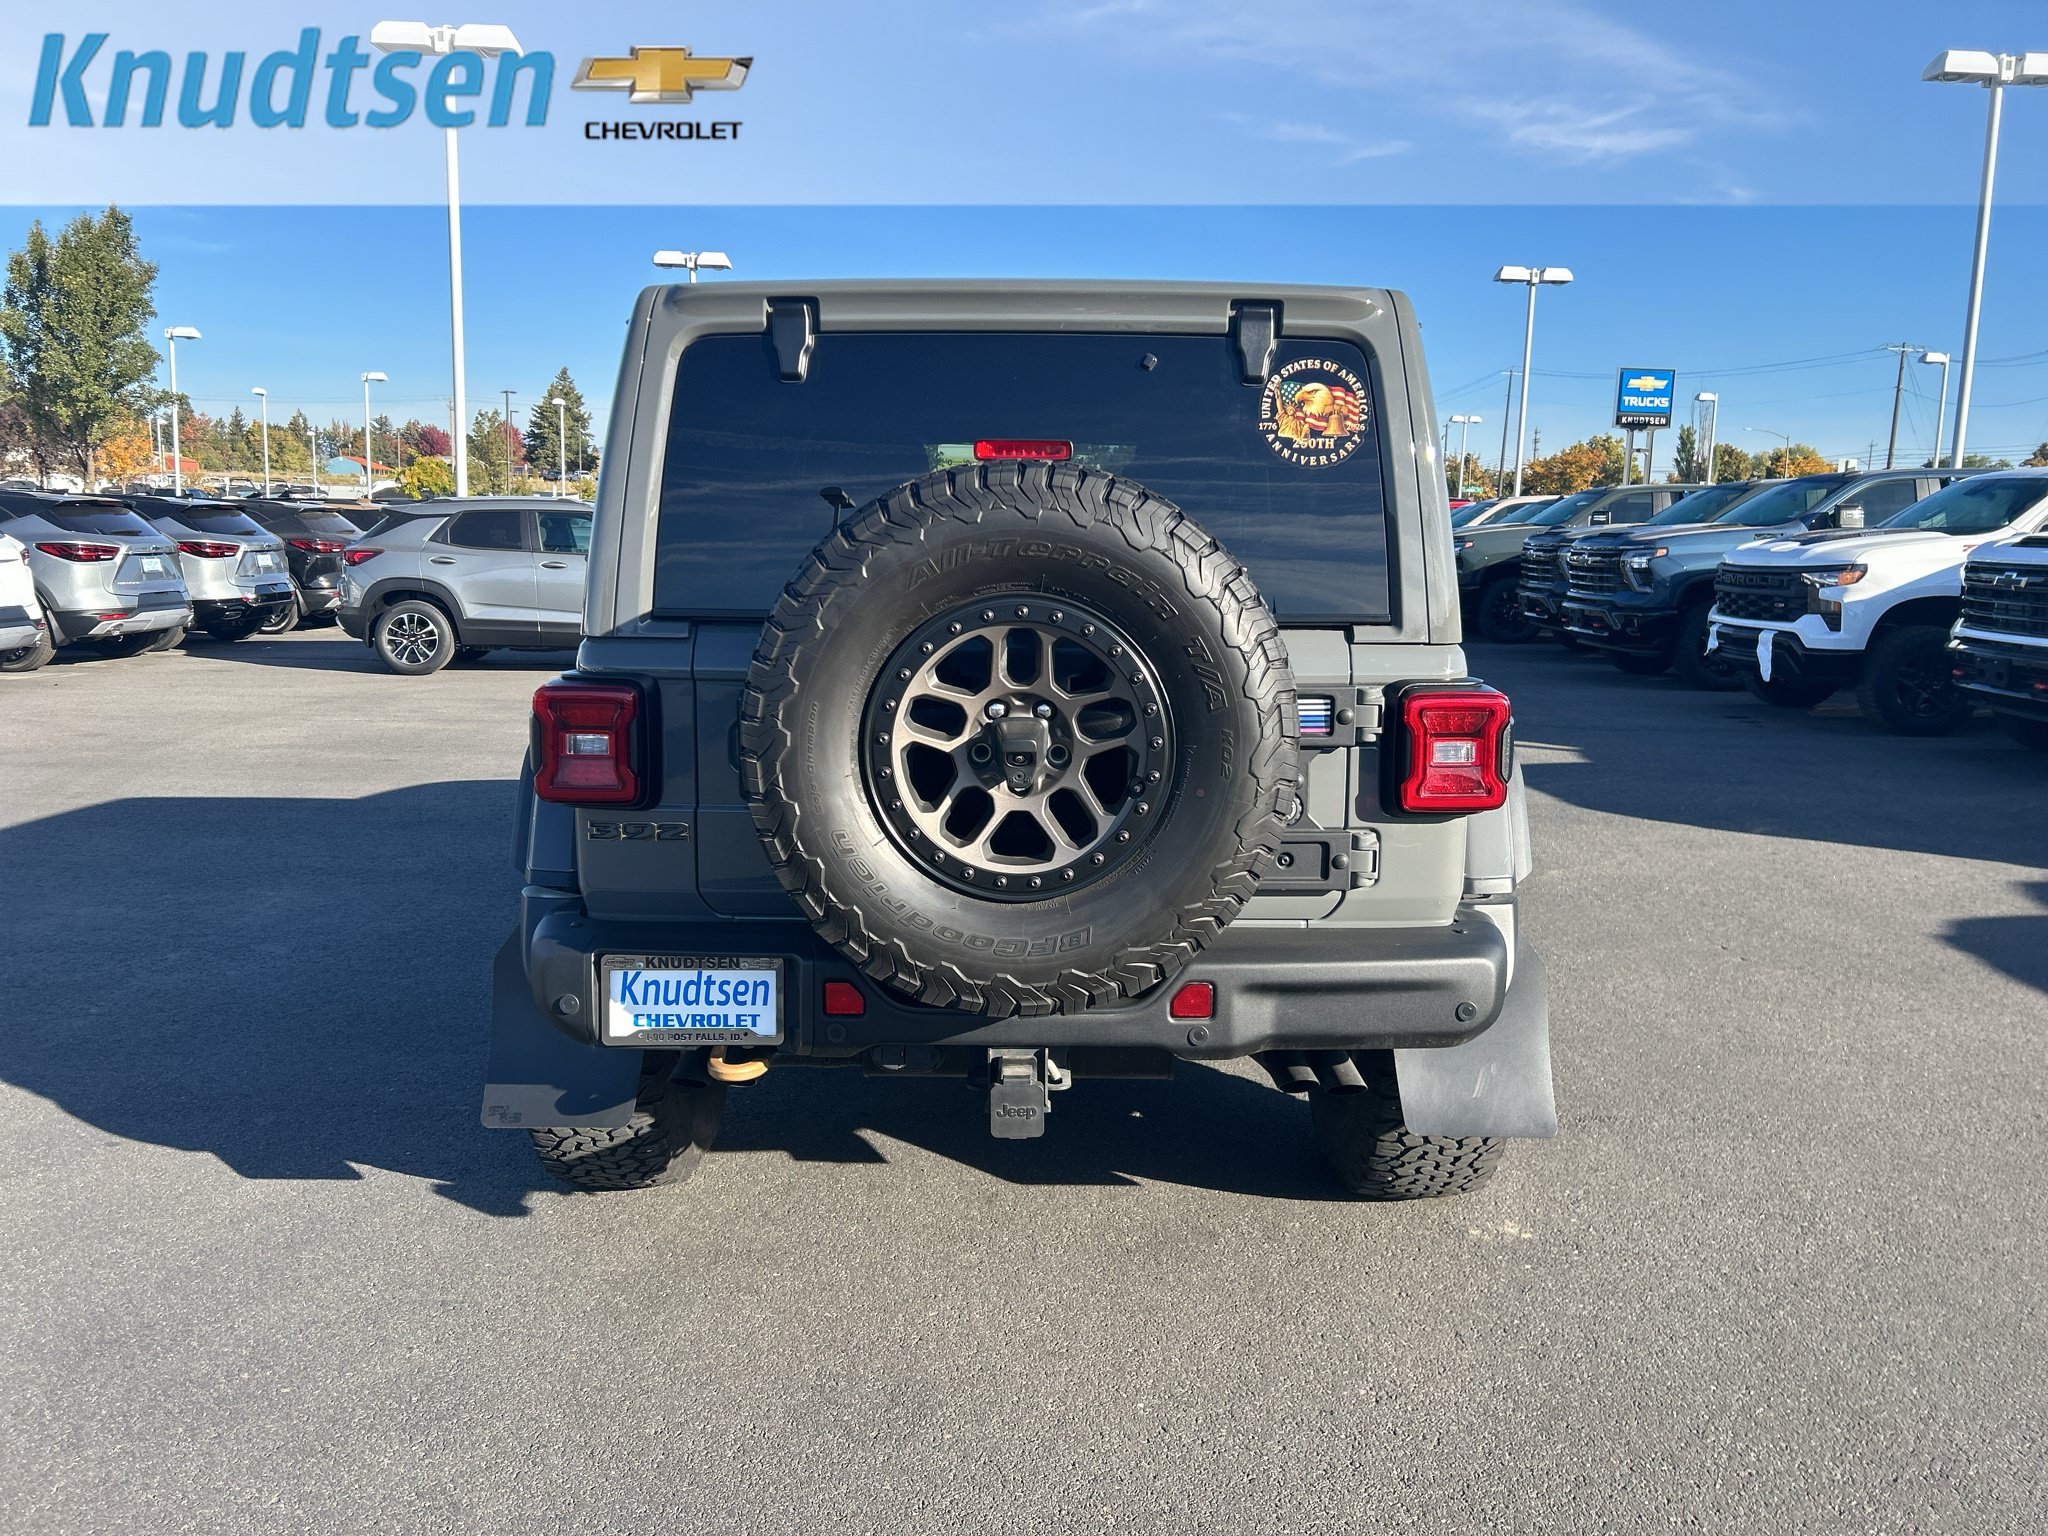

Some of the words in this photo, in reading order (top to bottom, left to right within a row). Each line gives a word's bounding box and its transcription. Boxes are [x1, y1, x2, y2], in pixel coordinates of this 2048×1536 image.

[1261, 374, 1282, 419] UNITED
[1280, 359, 1321, 378] STATES
[1323, 360, 1339, 373] OF
[1337, 368, 1368, 422] AMERICA
[1623, 395, 1670, 408] TRUCKS
[1258, 422, 1278, 431] 1776
[1346, 422, 1366, 431] 2026
[1621, 416, 1667, 425] KNUDTSEN
[1265, 433, 1361, 466] ANNIVERSARY
[1292, 437, 1335, 449] 250TH
[1185, 634, 1229, 712] T/A
[587, 820, 690, 842] 392
[831, 829, 1093, 958] BFGoodrich
[645, 956, 741, 969] KNUDTSEN
[620, 970, 770, 1007] Knudtsen
[633, 1013, 761, 1028] CHEVROLET
[667, 1032, 692, 1041] POST
[996, 1104, 1037, 1120] Jeep
